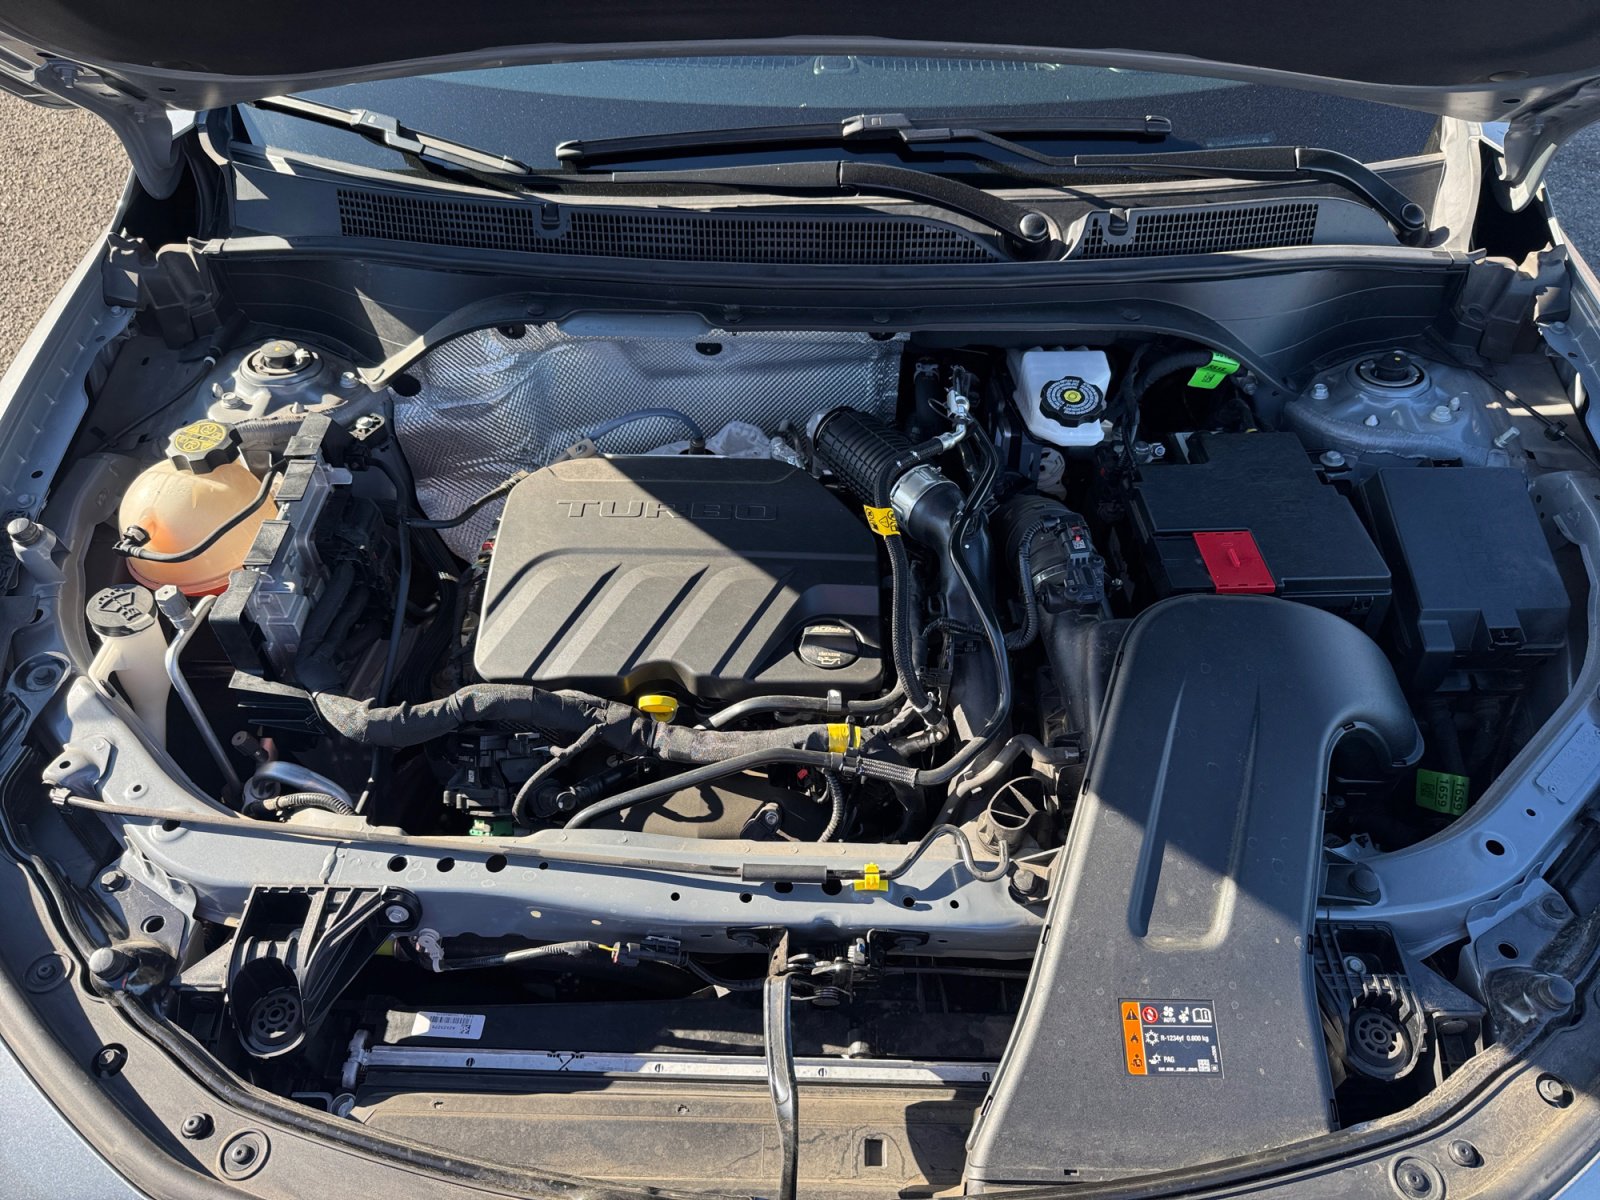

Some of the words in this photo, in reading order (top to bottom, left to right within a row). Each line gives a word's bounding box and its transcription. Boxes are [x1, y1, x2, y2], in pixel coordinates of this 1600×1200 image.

[557, 500, 777, 520] TURBO
[1438, 779, 1449, 807] 1659
[1453, 782, 1465, 810] 1659
